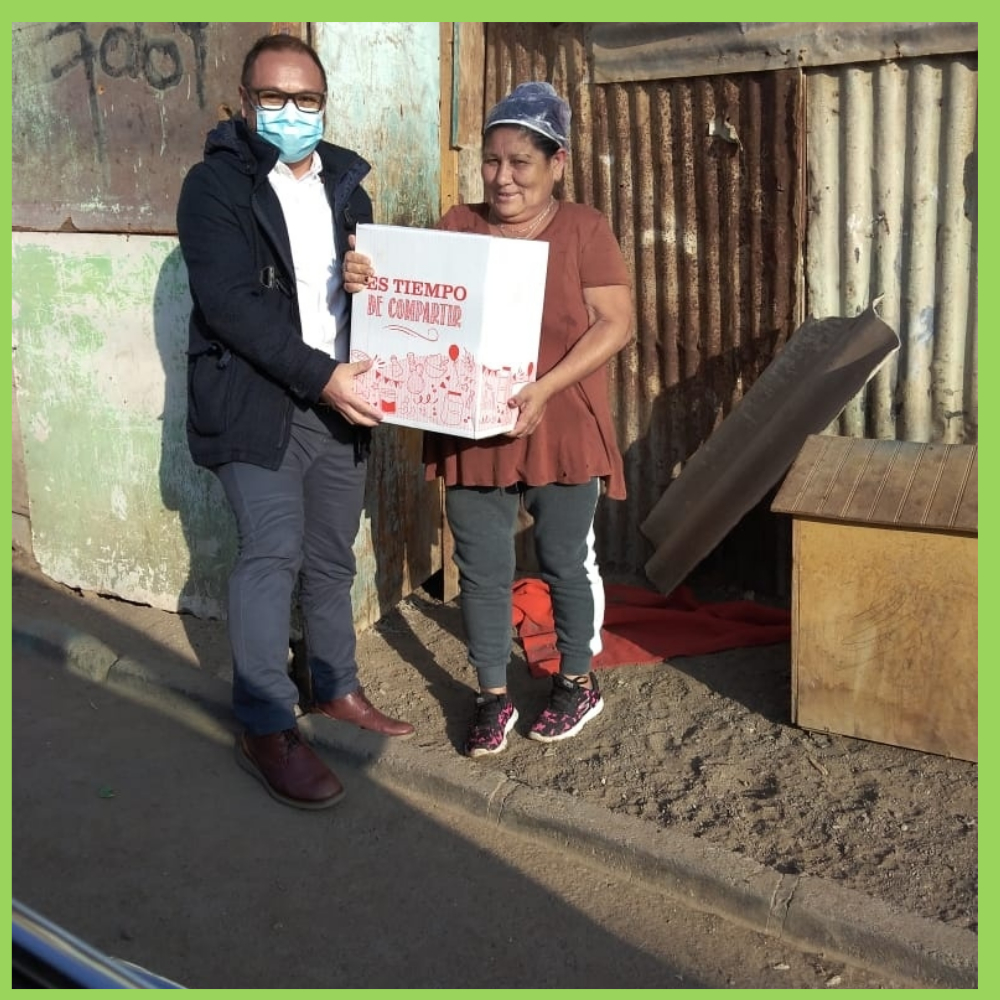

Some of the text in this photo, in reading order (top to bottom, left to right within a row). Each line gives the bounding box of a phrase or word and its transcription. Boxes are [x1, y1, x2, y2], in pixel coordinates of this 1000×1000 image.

[393, 278, 467, 302] TIEMPO
[366, 294, 462, 328] DE COMPARTIR
